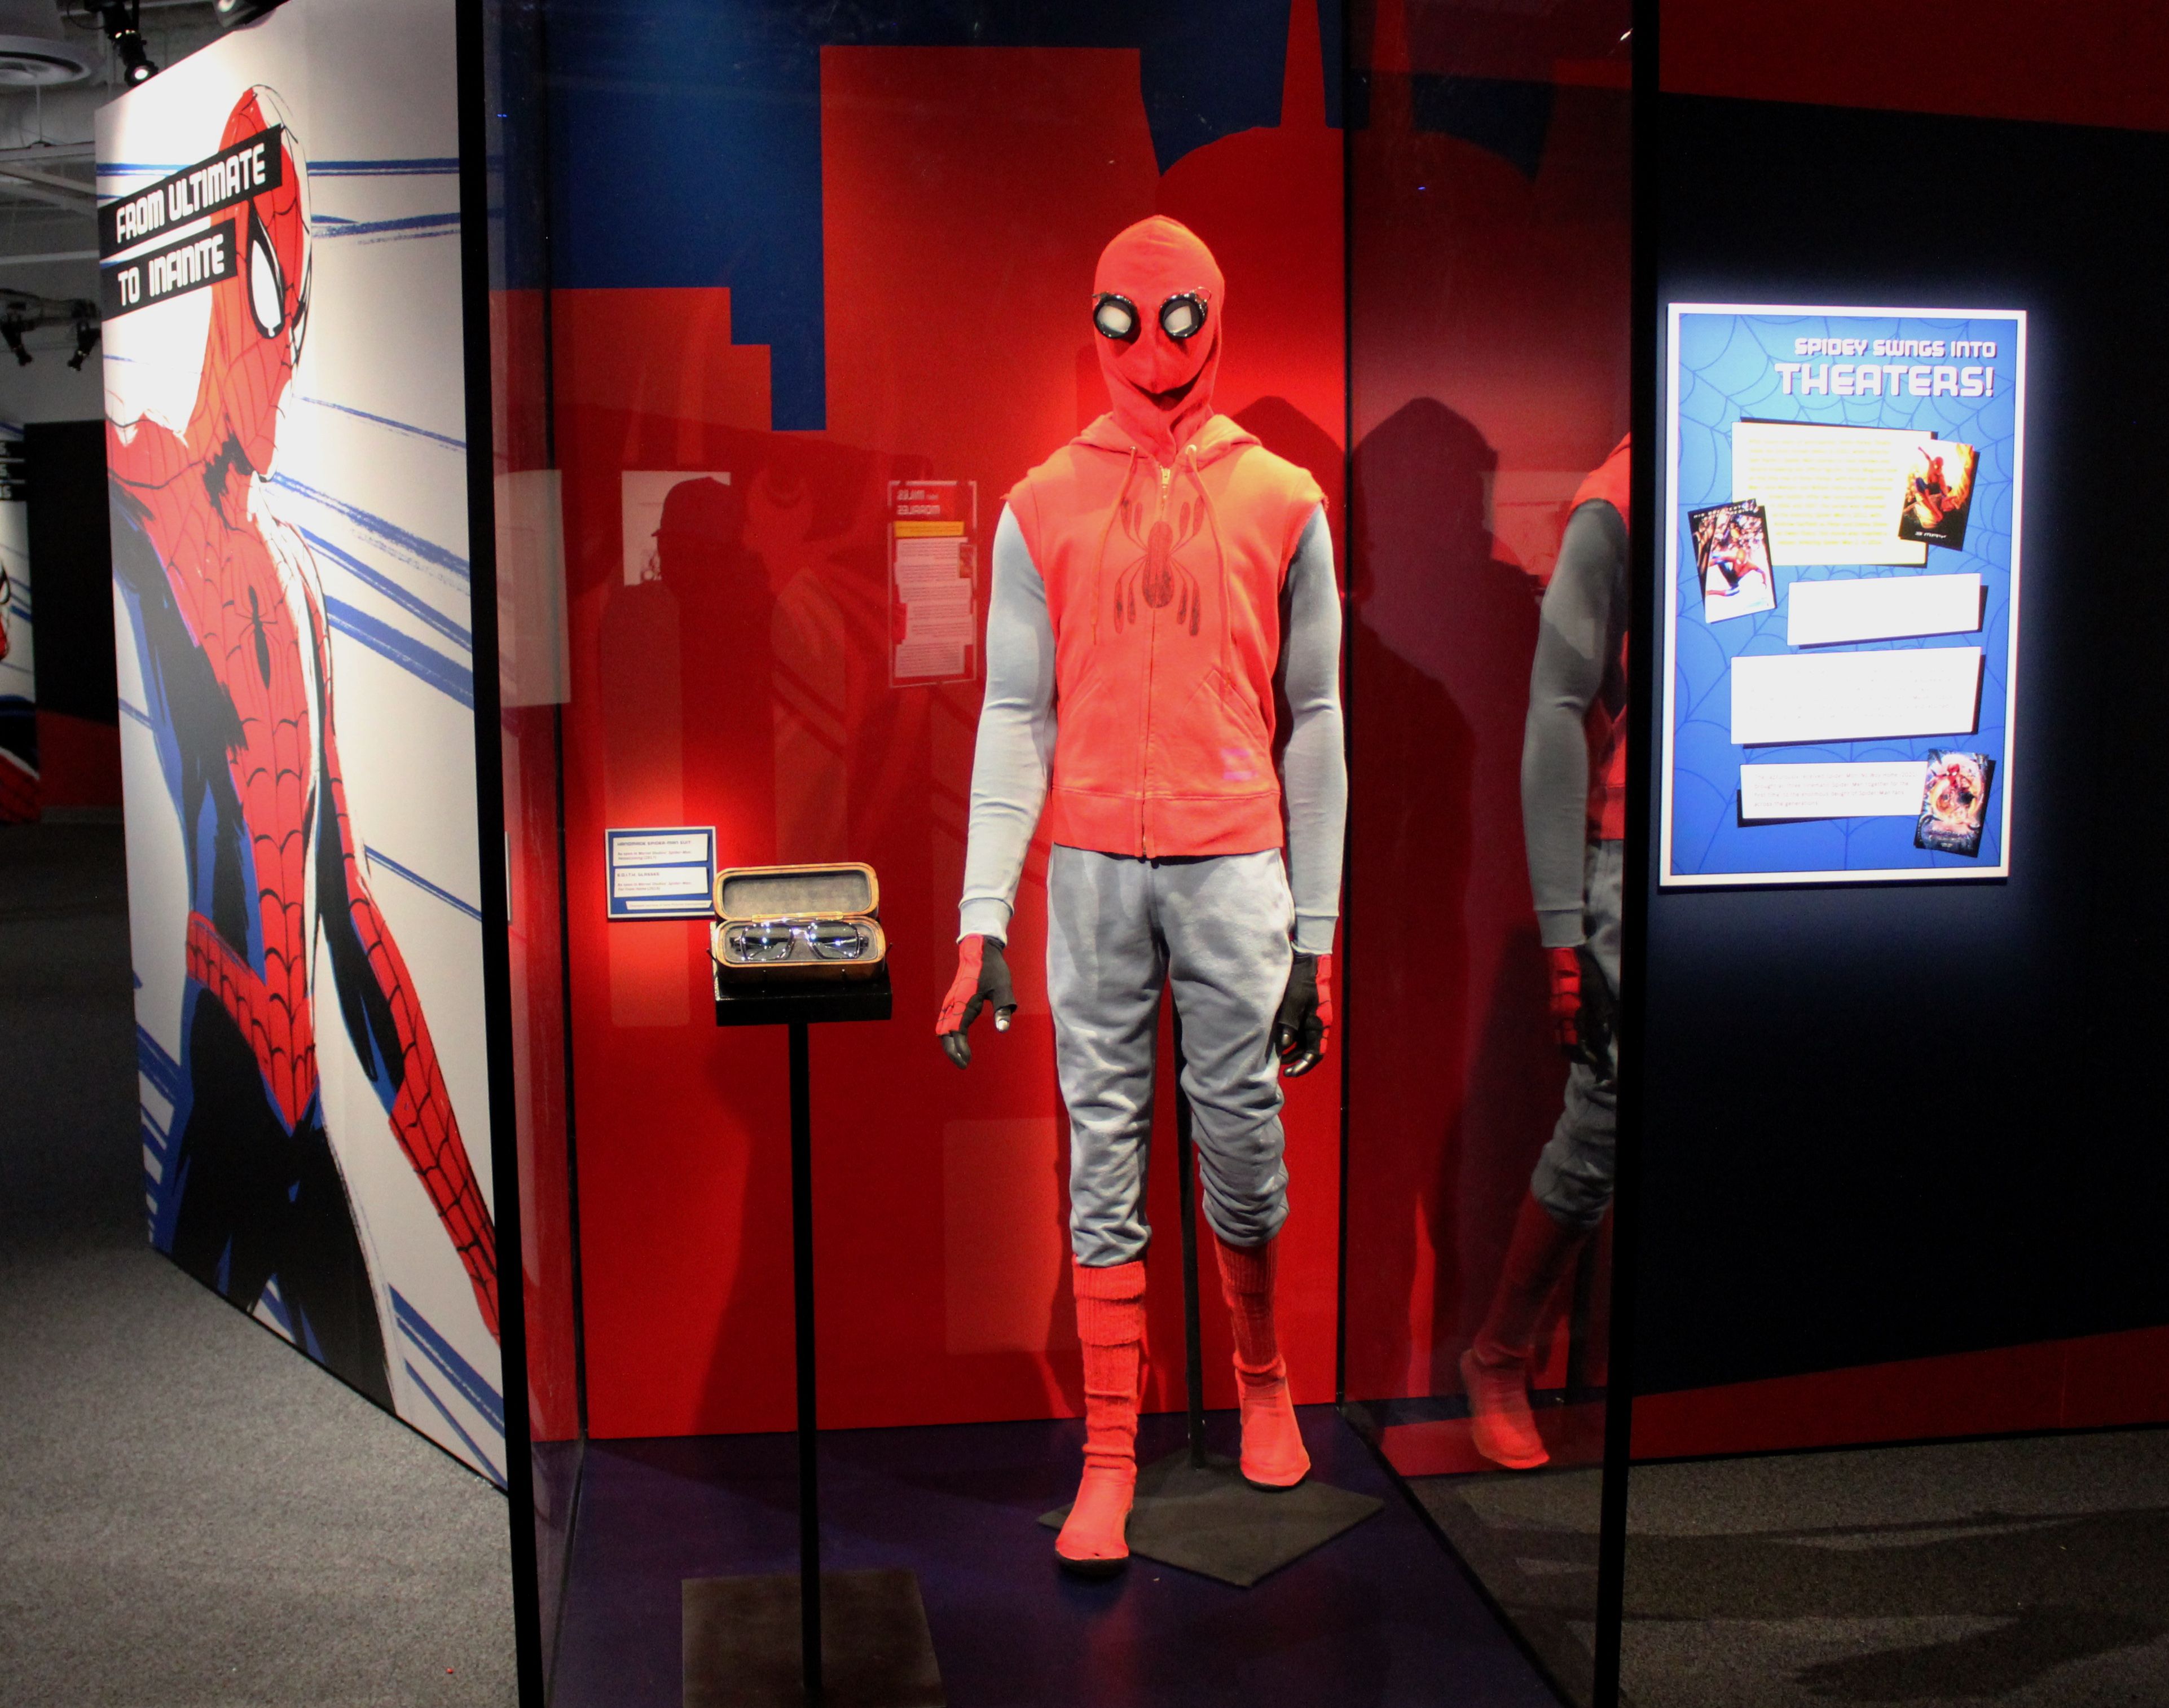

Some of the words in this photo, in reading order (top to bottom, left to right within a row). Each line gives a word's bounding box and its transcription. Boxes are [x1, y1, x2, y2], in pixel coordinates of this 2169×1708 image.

[116, 189, 165, 244] FROM
[169, 143, 266, 222] ULTIMATE
[117, 266, 140, 306] TO
[148, 234, 225, 297] INFINITE
[1794, 338, 1868, 356] SPIDEY
[1950, 341, 1997, 358] INTO
[1774, 363, 1995, 397] THEATERS!
